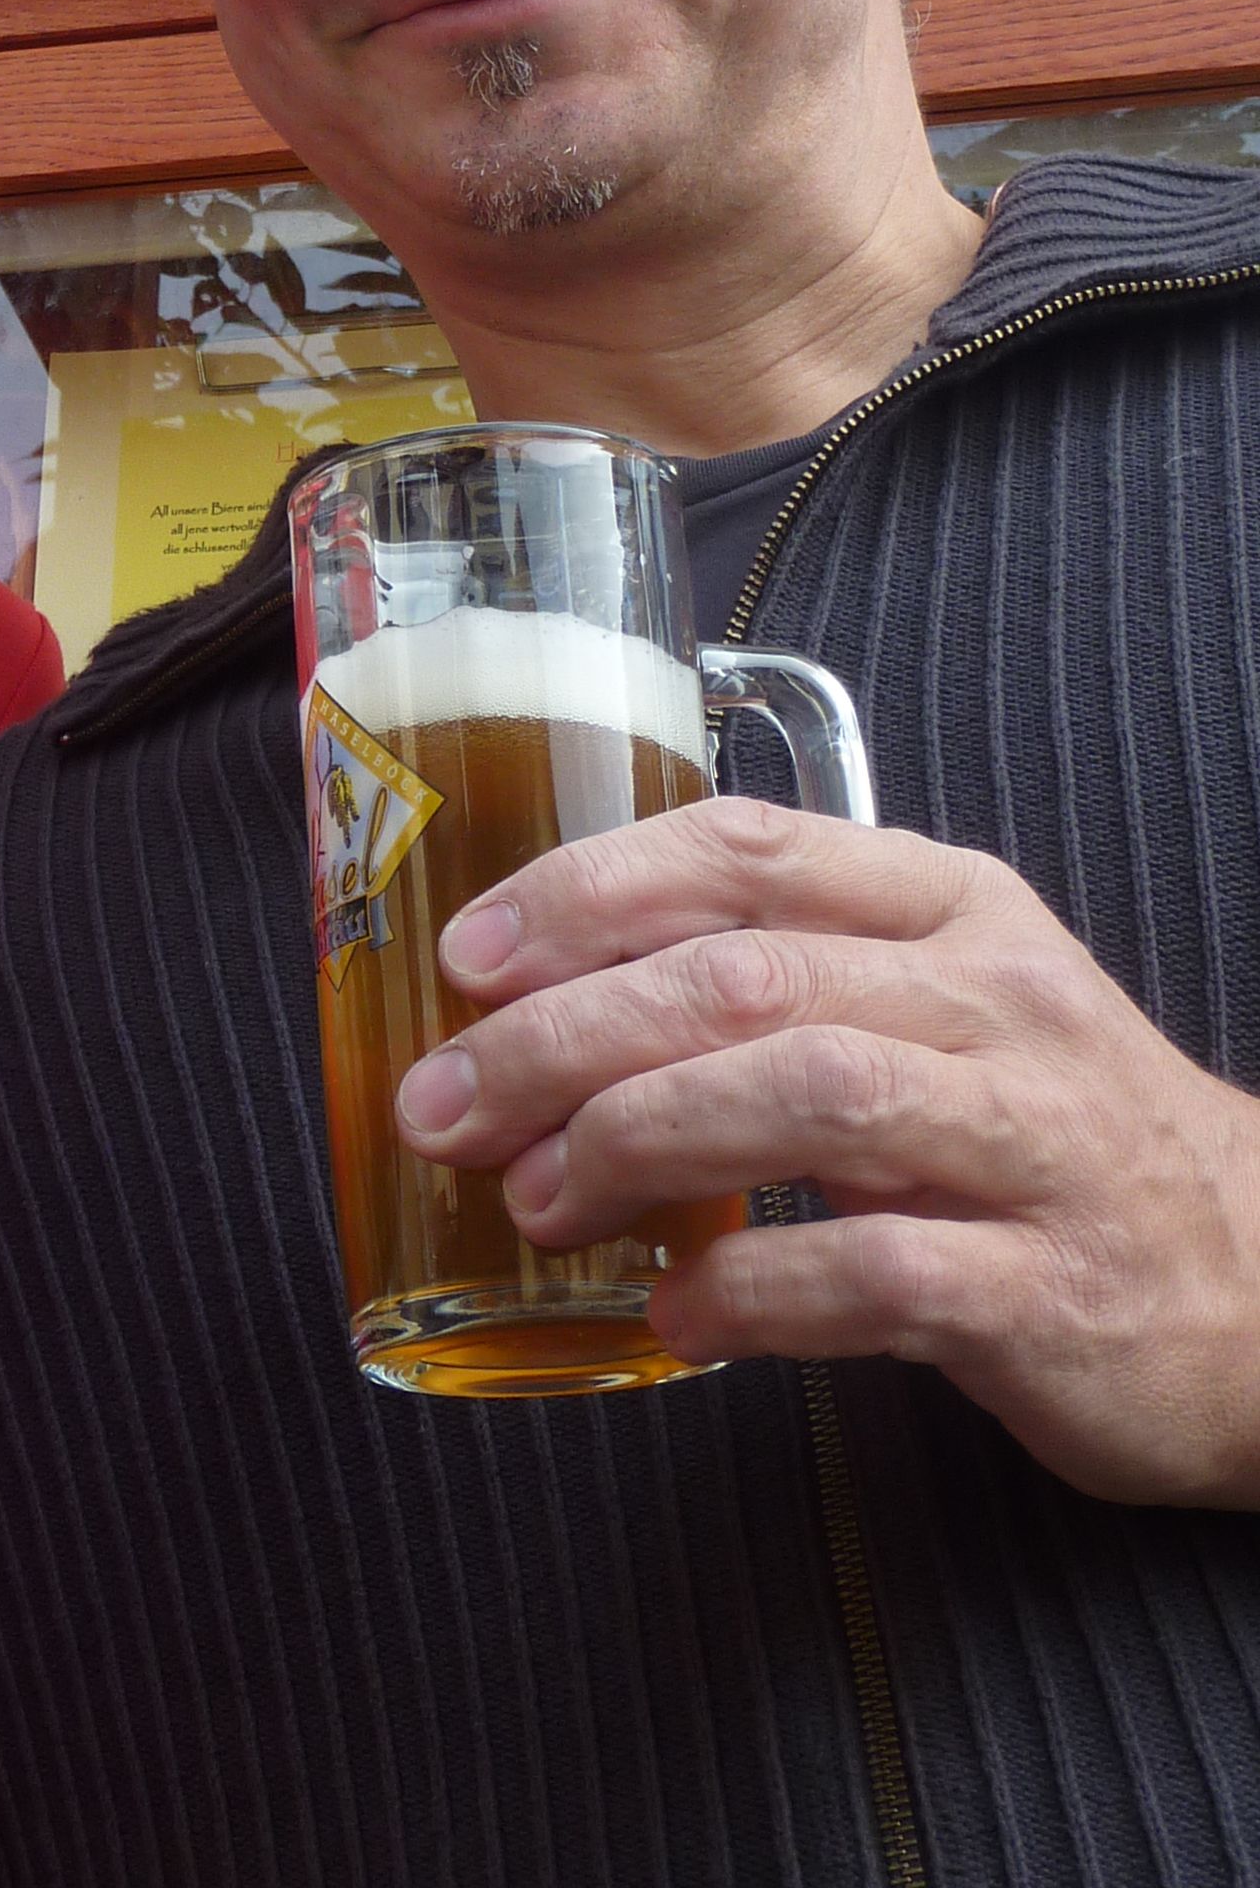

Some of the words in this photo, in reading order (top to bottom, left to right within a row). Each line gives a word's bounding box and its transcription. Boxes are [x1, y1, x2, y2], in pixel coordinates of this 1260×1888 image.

[150, 504, 169, 519] All
[171, 506, 208, 516] unsere
[210, 501, 244, 516] Biere
[170, 523, 184, 535] all
[184, 525, 209, 540] jene
[211, 519, 265, 533] wertvolle
[163, 543, 180, 555] die
[183, 538, 247, 554] schlussendl
